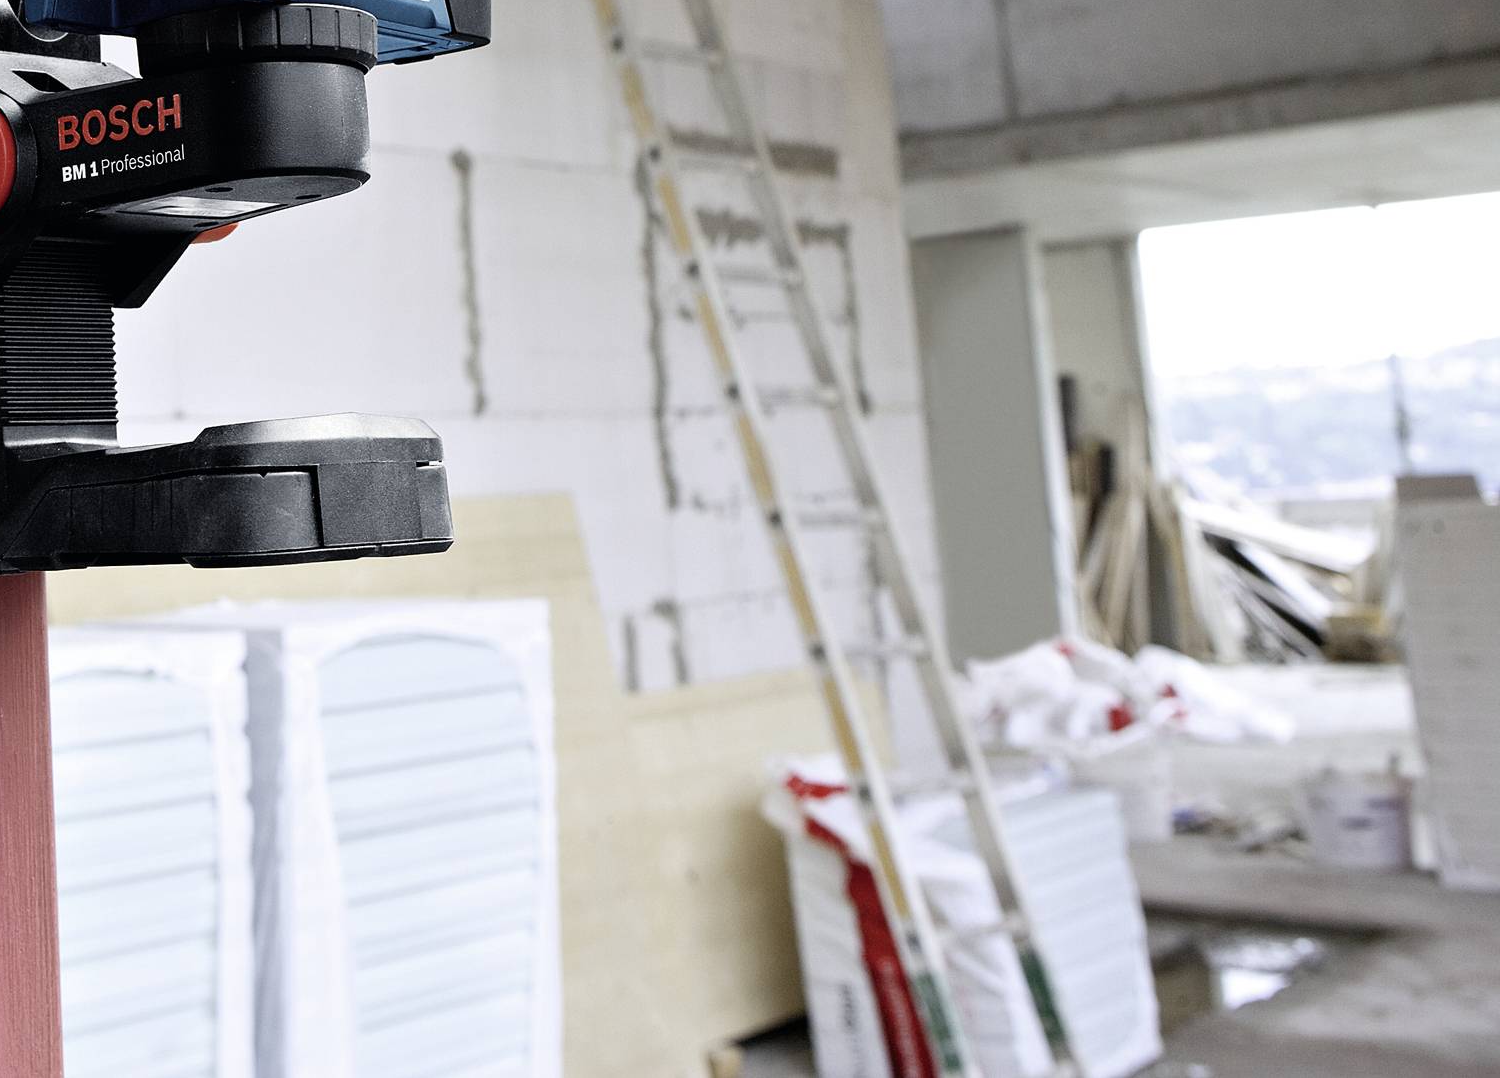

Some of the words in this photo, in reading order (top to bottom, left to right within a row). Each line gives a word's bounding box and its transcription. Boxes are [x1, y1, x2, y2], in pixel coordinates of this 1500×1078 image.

[56, 93, 182, 152] BOSCH
[61, 163, 87, 183] BM
[90, 161, 99, 178] 1
[101, 143, 186, 176] Professional
